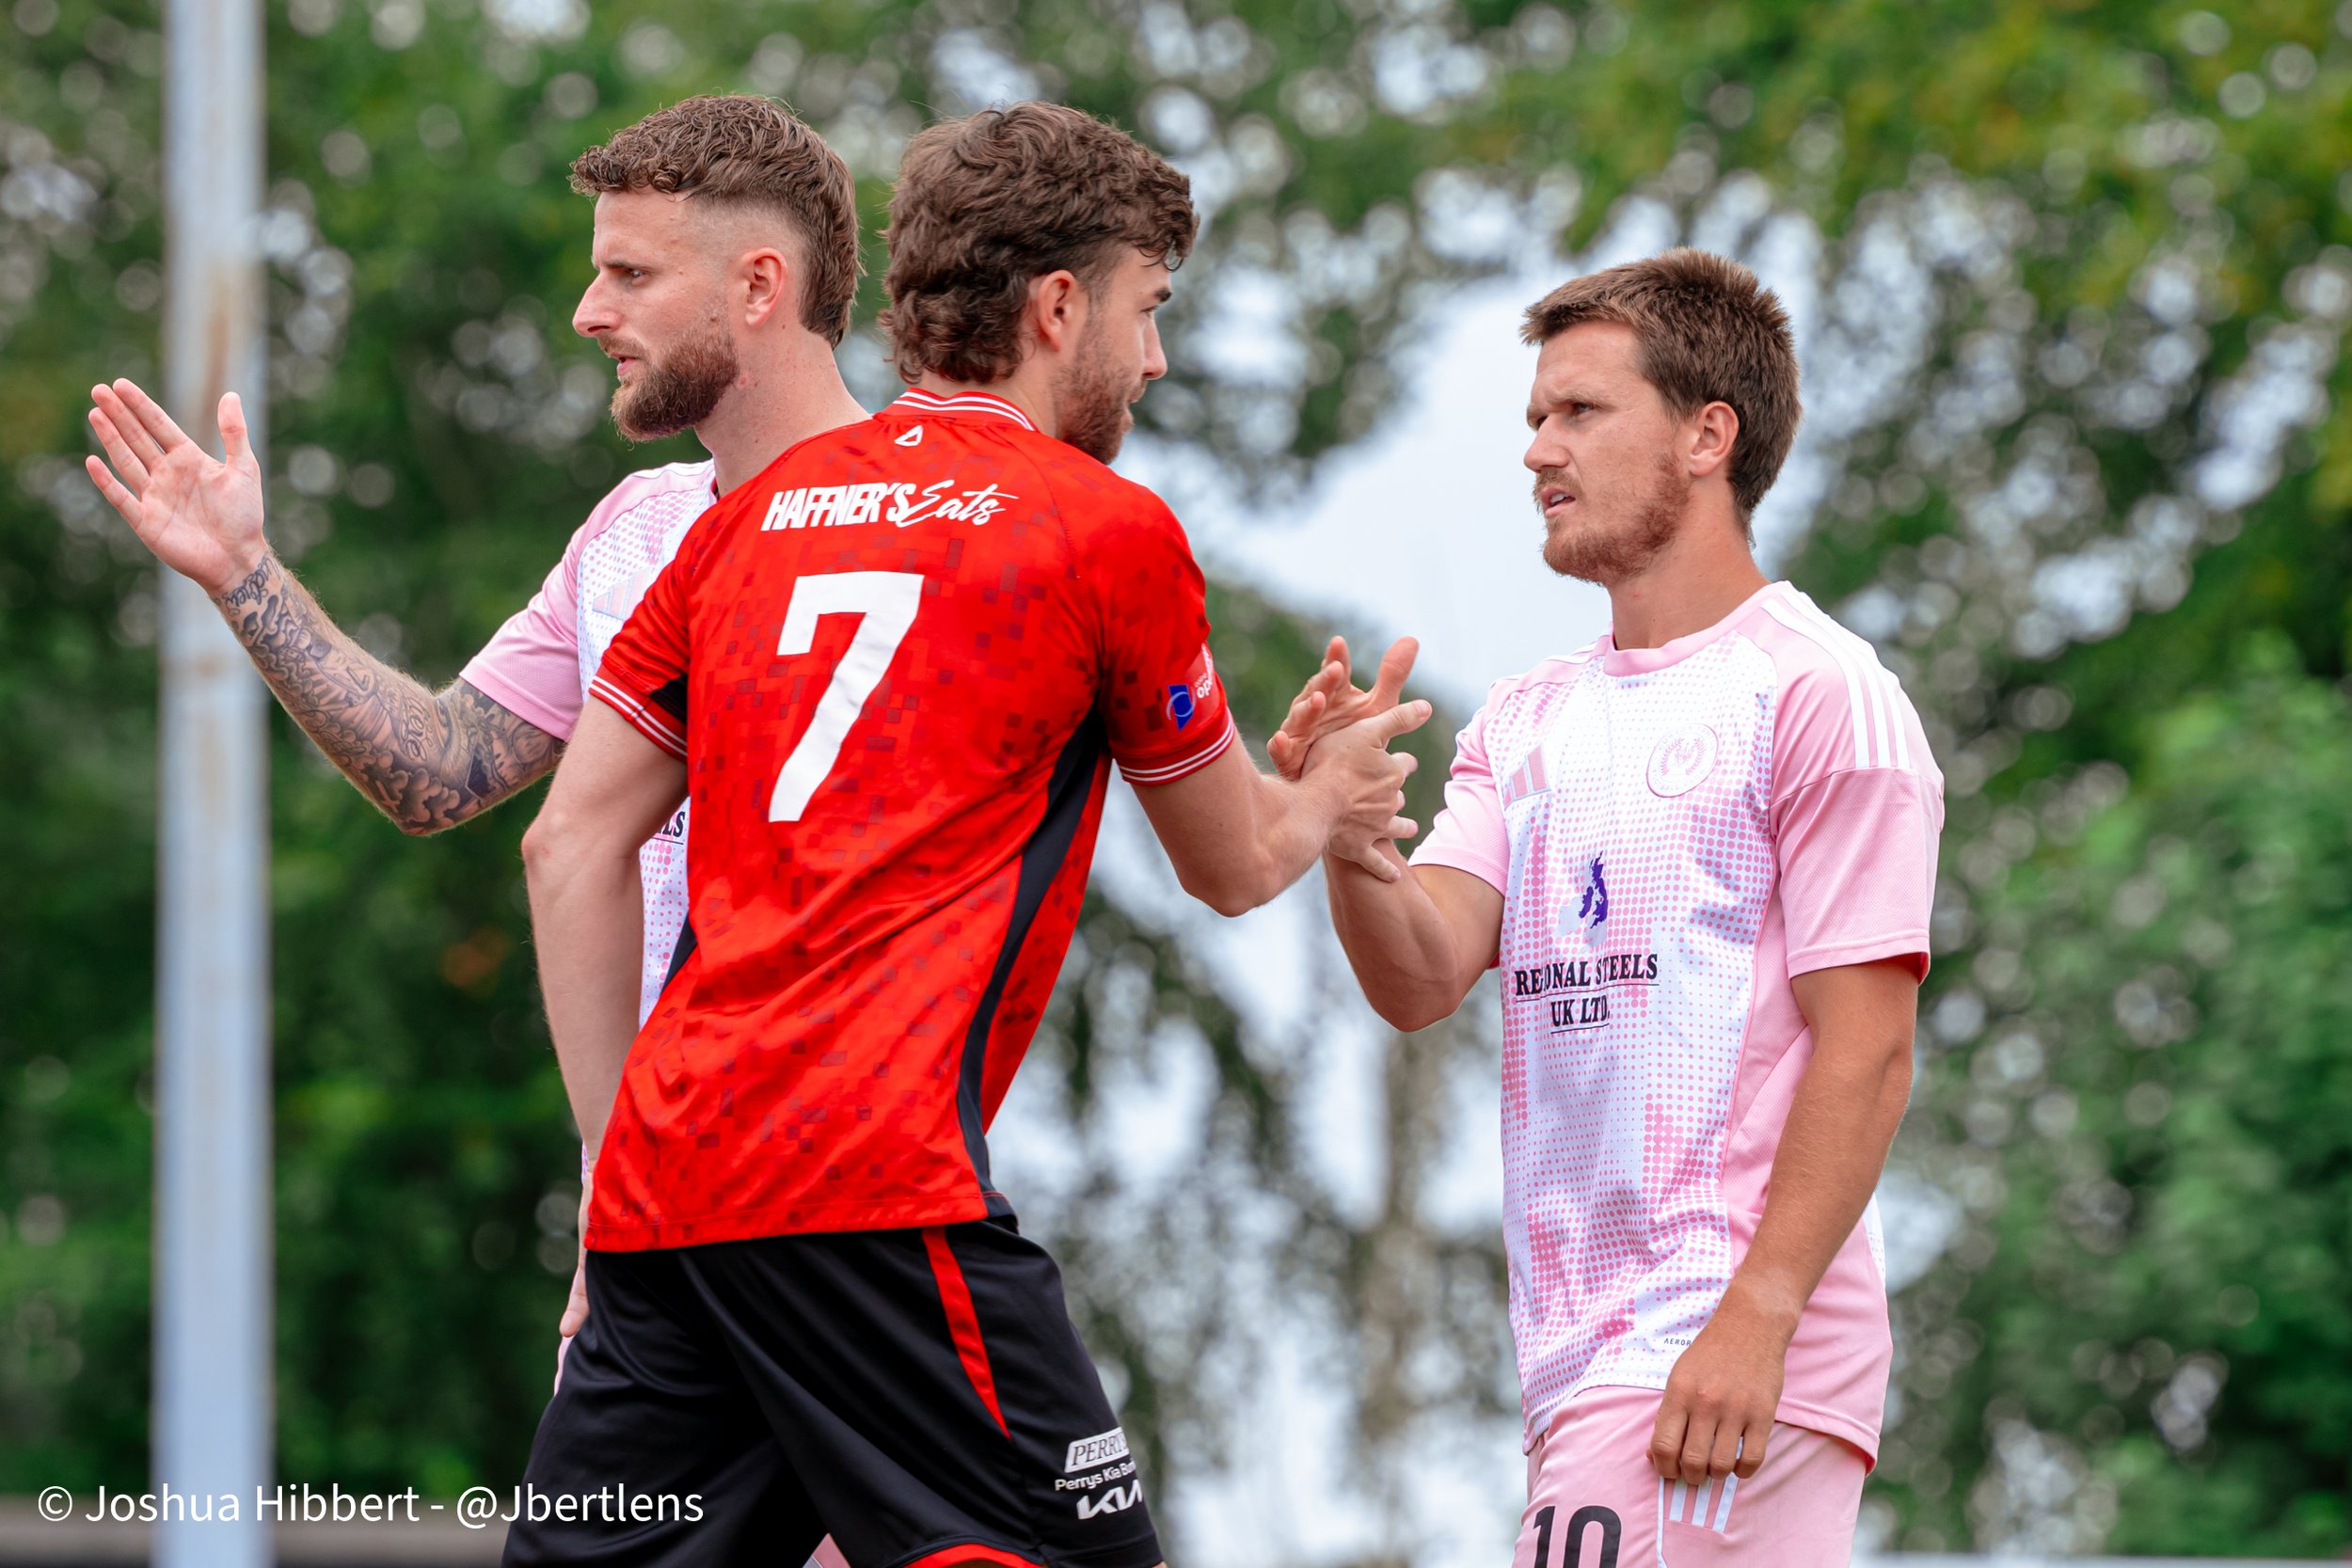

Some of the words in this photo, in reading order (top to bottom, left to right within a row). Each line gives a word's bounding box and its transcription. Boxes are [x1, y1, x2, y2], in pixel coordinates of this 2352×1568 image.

[896, 480, 1020, 529] Eats
[768, 570, 925, 823] 7
[1515, 961, 1591, 997] REONAL
[1596, 954, 1658, 985] STEELS
[1550, 999, 1575, 1027] UK
[1055, 1473, 1104, 1491] Perrys
[1103, 1467, 1122, 1482] Kia
